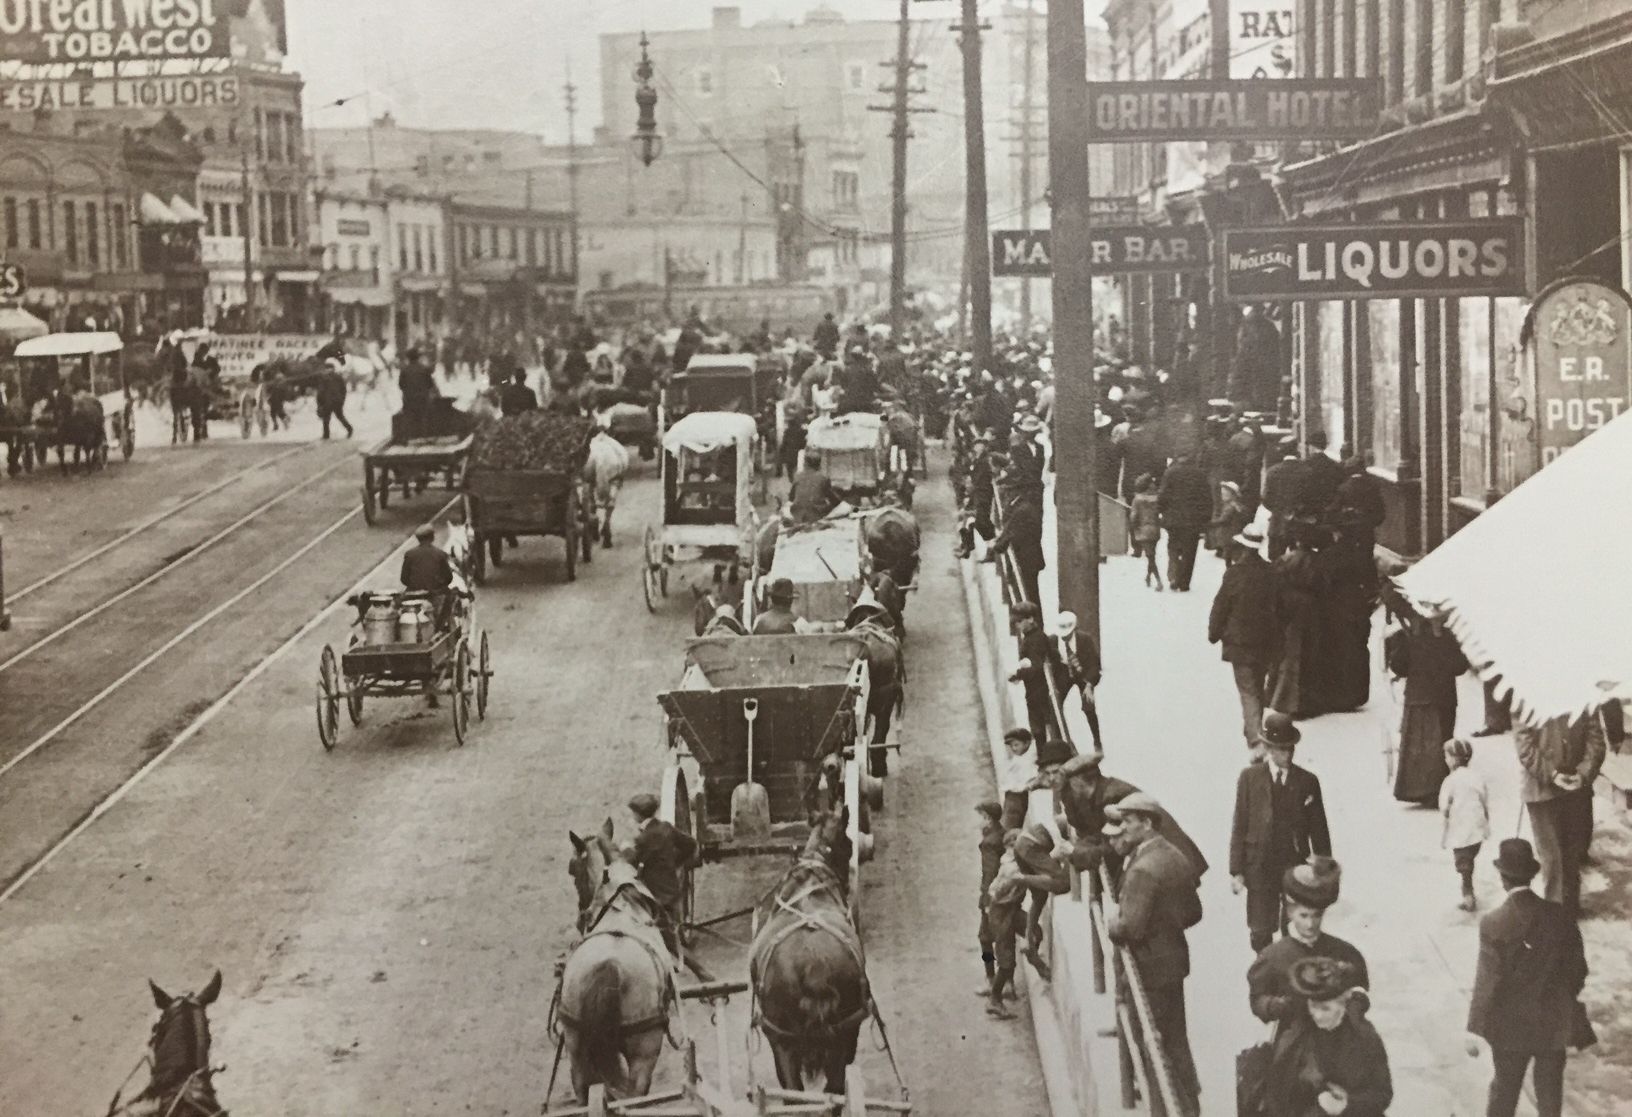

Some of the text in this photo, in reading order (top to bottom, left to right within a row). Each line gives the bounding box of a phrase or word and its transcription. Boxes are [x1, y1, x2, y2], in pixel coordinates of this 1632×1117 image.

[41, 28, 213, 58] TOBACCO
[113, 79, 238, 107] LIQUORS
[1096, 91, 1376, 130] ORIENTAL HOTEL
[1559, 356, 1610, 382] E.R.
[1546, 398, 1624, 431] POST
